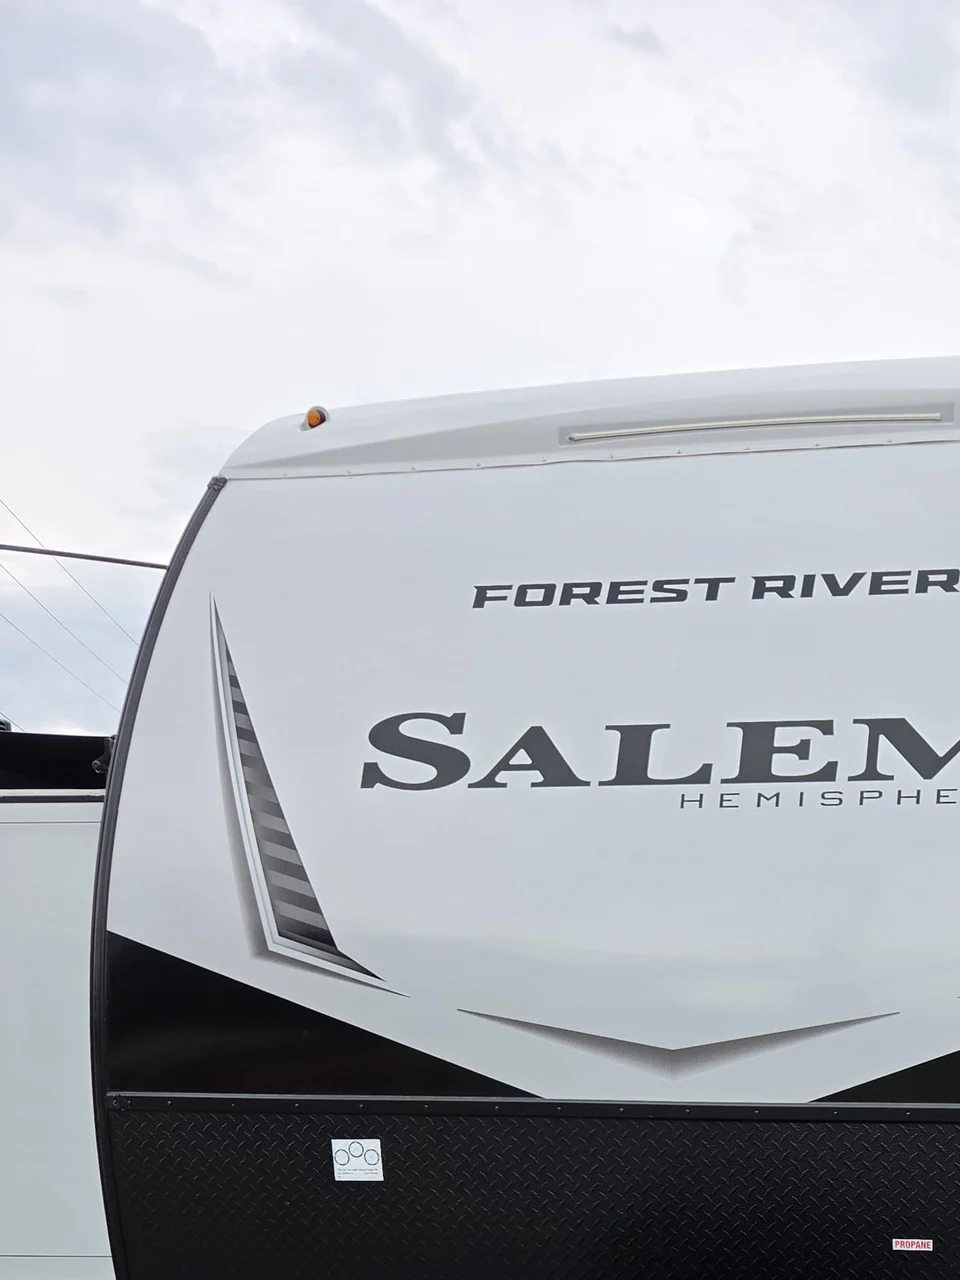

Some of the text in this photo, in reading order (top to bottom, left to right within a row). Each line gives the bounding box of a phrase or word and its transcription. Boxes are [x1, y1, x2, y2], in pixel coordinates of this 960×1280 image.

[472, 568, 960, 609] FOREST RIVER
[894, 1240, 932, 1249] PROPANE
